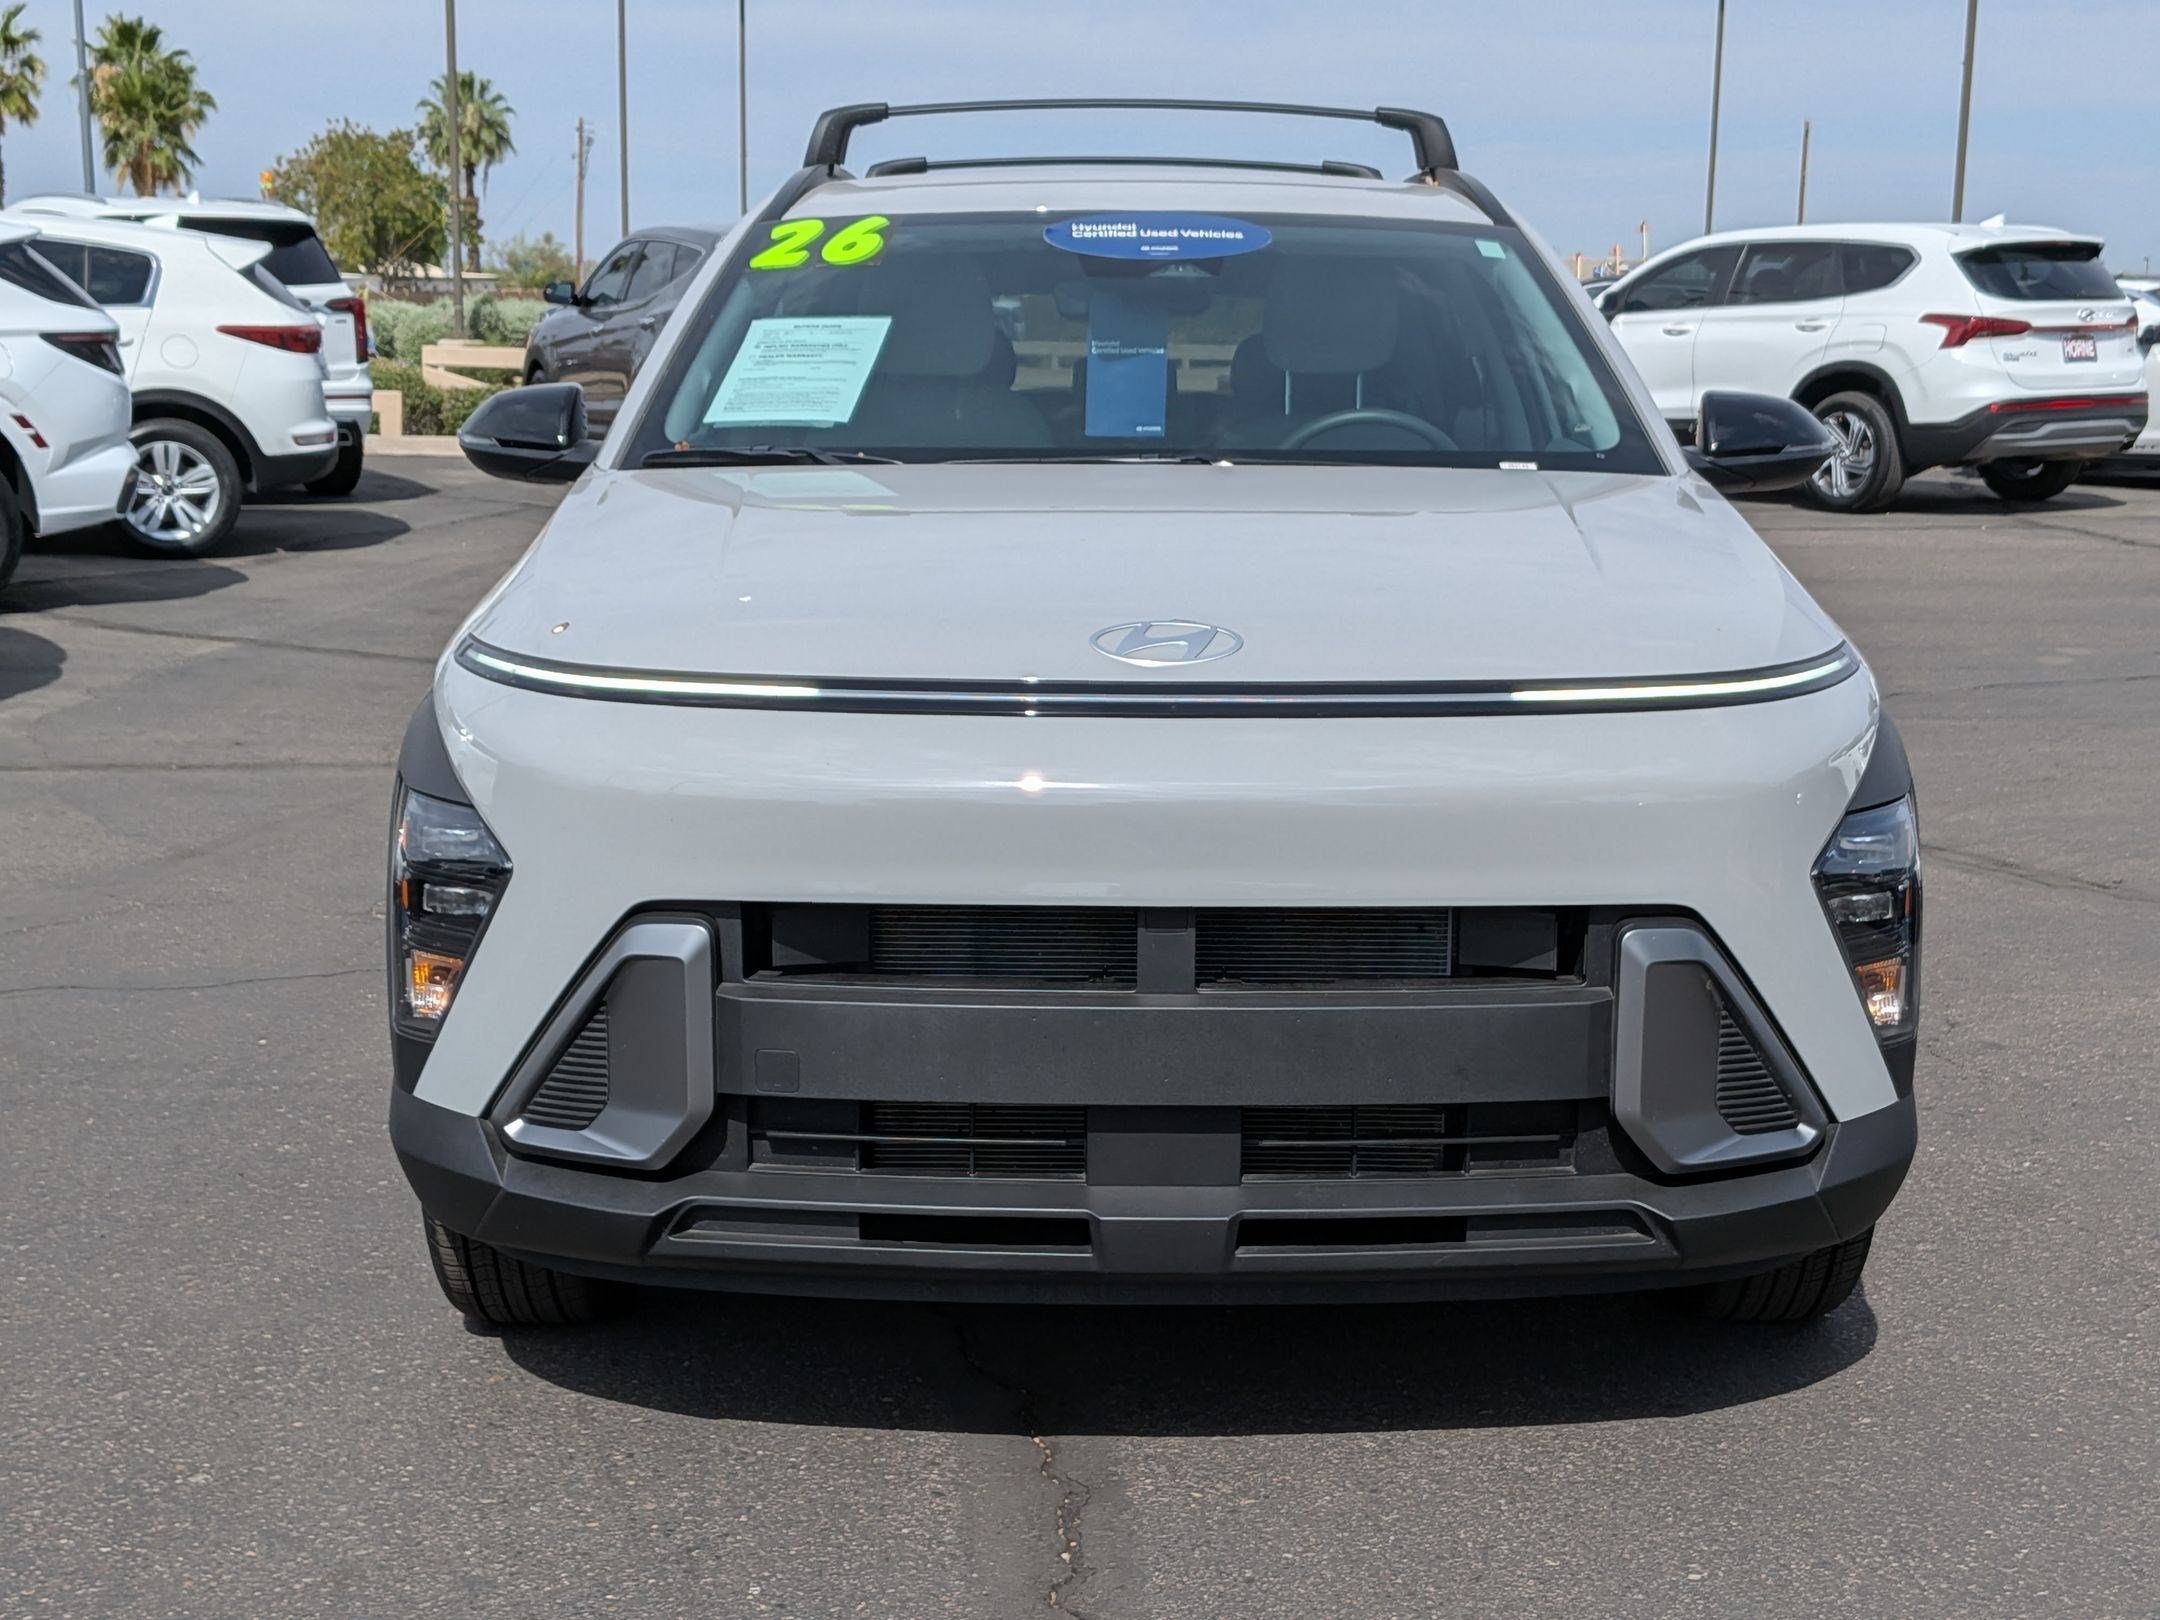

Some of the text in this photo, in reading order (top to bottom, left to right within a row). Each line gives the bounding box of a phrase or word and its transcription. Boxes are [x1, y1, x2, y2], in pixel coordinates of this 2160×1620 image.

[1072, 222, 1137, 231] Hyundai
[1072, 228, 1244, 240] Certified Used Vehicles
[749, 216, 890, 269] 26
